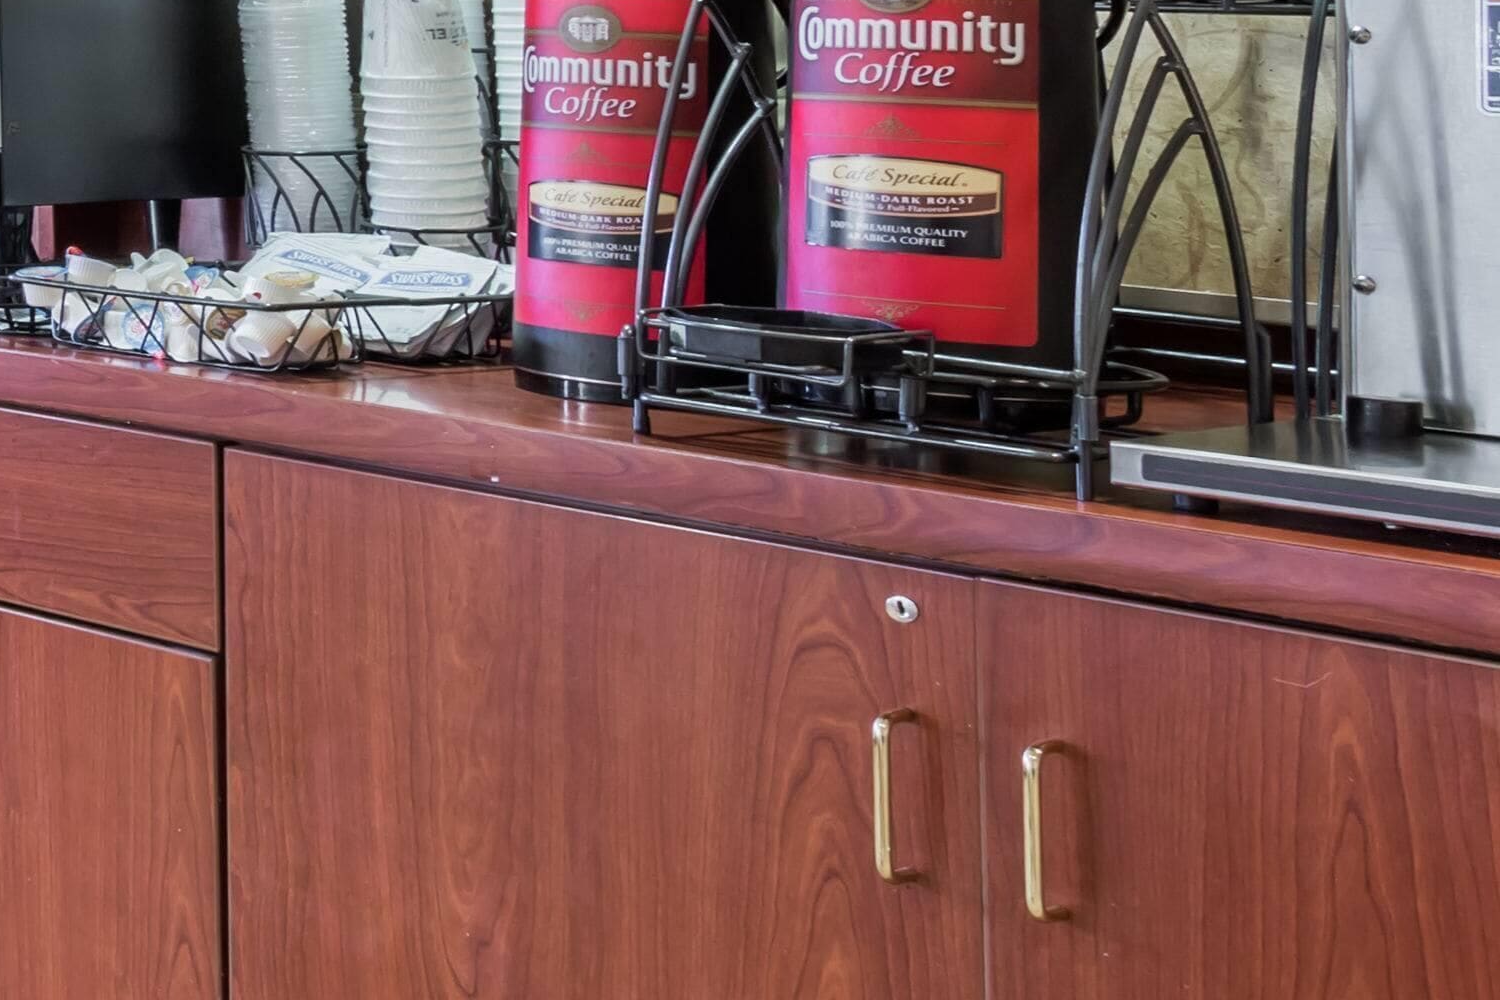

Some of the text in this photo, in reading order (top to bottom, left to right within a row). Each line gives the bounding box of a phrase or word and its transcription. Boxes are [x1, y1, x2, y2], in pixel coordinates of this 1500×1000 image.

[799, 6, 1026, 66] Community
[834, 51, 955, 92] Coffee
[544, 86, 637, 122] Coffee
[880, 168, 965, 188] Special
[581, 191, 646, 209] Special
[825, 186, 975, 205] MEDIUM-DARK ROAST
[539, 207, 646, 224] MEDIUM-DARK ROA
[848, 231, 946, 247] ARABICA COFFEE
[855, 221, 911, 234] PREMIUM
[914, 226, 968, 239] QUALITY
[555, 247, 632, 261] ARABICA COFFEE
[562, 238, 605, 250] PREMIUM
[606, 242, 641, 253] QUALI
